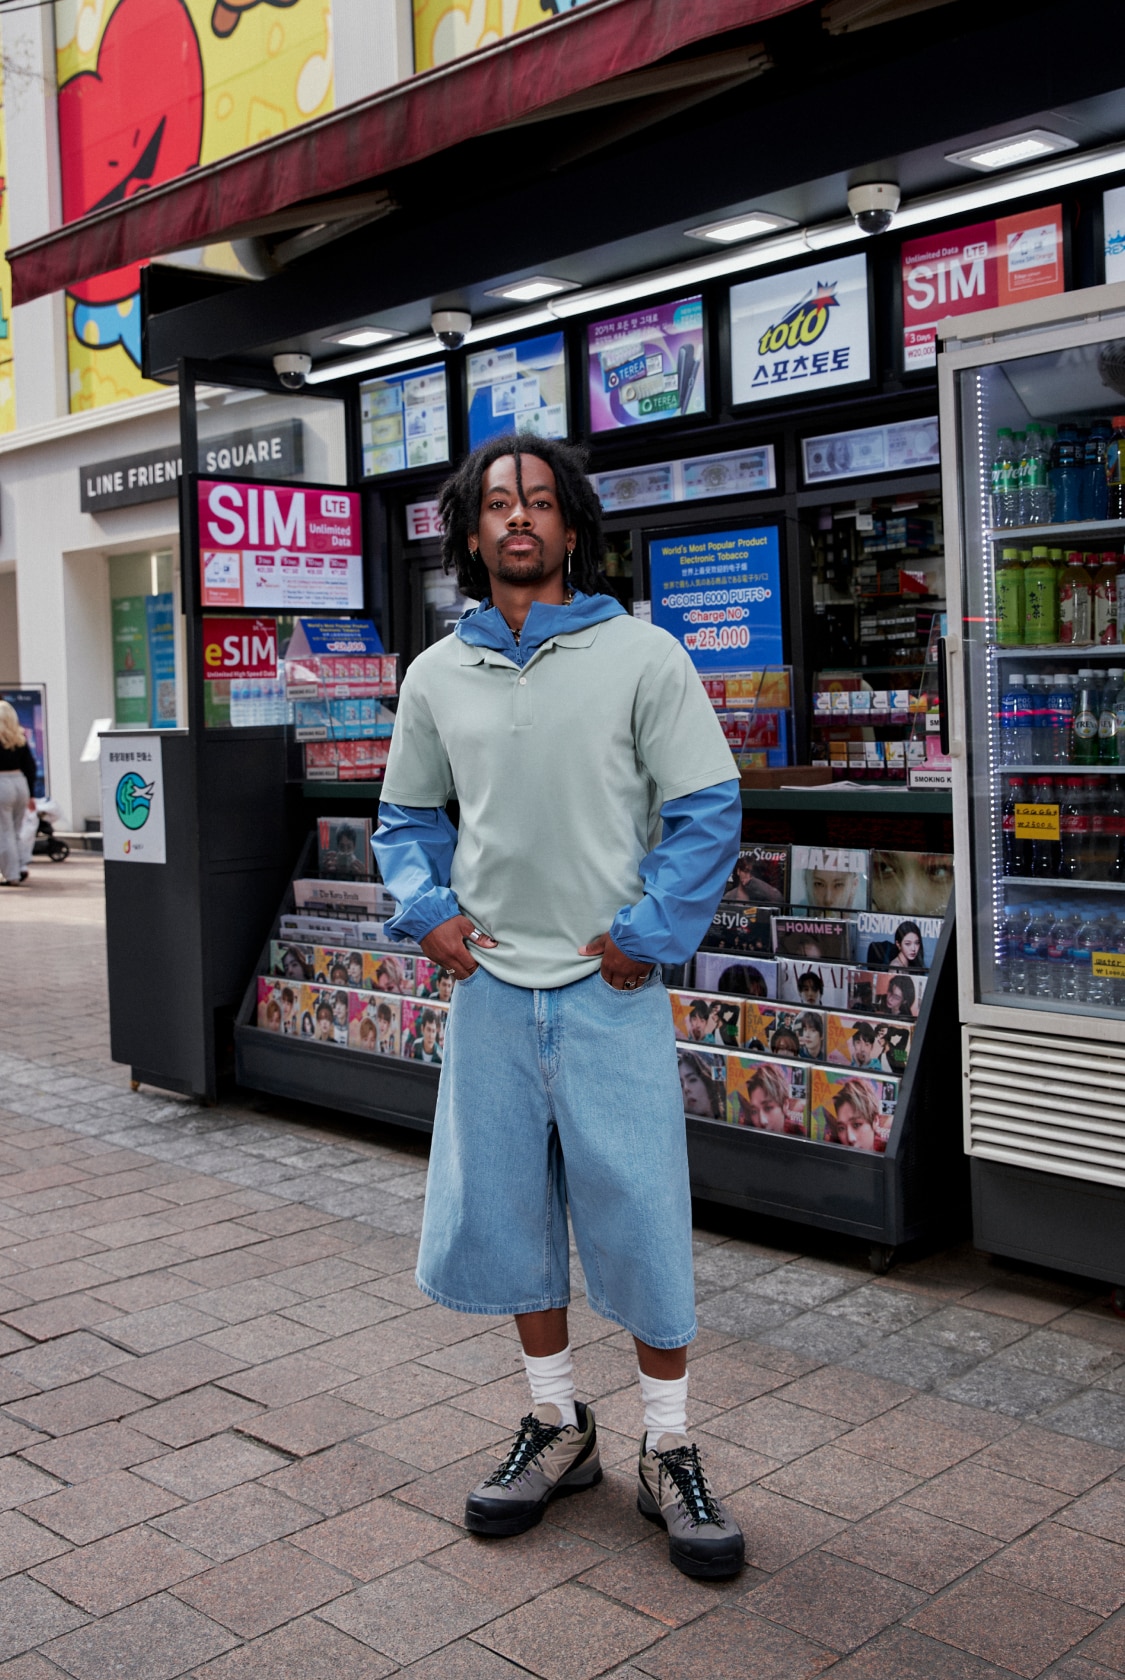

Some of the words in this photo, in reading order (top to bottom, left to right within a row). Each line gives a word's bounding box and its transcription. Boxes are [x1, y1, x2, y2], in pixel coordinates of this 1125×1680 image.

[905, 250, 940, 264] Unlimited
[942, 246, 959, 257] Data
[966, 245, 985, 258] LTE
[906, 258, 986, 310] SIM
[758, 306, 829, 356] toto
[909, 333, 916, 343] 3
[917, 332, 931, 343] Days
[620, 360, 645, 379] TEREA
[751, 345, 850, 388] 스포츠토토
[653, 395, 677, 407] TEREA
[87, 470, 123, 498] LINE
[128, 459, 183, 488] FRIEN
[206, 438, 282, 472] SQUARE
[992, 464, 1019, 483] prite
[207, 484, 307, 547] SIM
[325, 500, 346, 514] LTE
[309, 523, 351, 536] Unlimited
[332, 536, 351, 547] Data
[662, 545, 687, 556] World's
[689, 543, 706, 553] Most
[708, 541, 735, 551] Popular
[738, 536, 768, 547] Product
[680, 555, 715, 565] Electronic
[717, 551, 748, 561] Tobacco
[668, 593, 702, 607] GCORE
[730, 588, 764, 602] PUFFS
[690, 610, 724, 623] Charge
[727, 608, 742, 619] NO
[205, 635, 276, 667] eSIM
[914, 776, 945, 784] SMOKING
[753, 847, 787, 862] Stone
[786, 922, 843, 935] HOMME+
[857, 912, 944, 938] COSMOTAN
